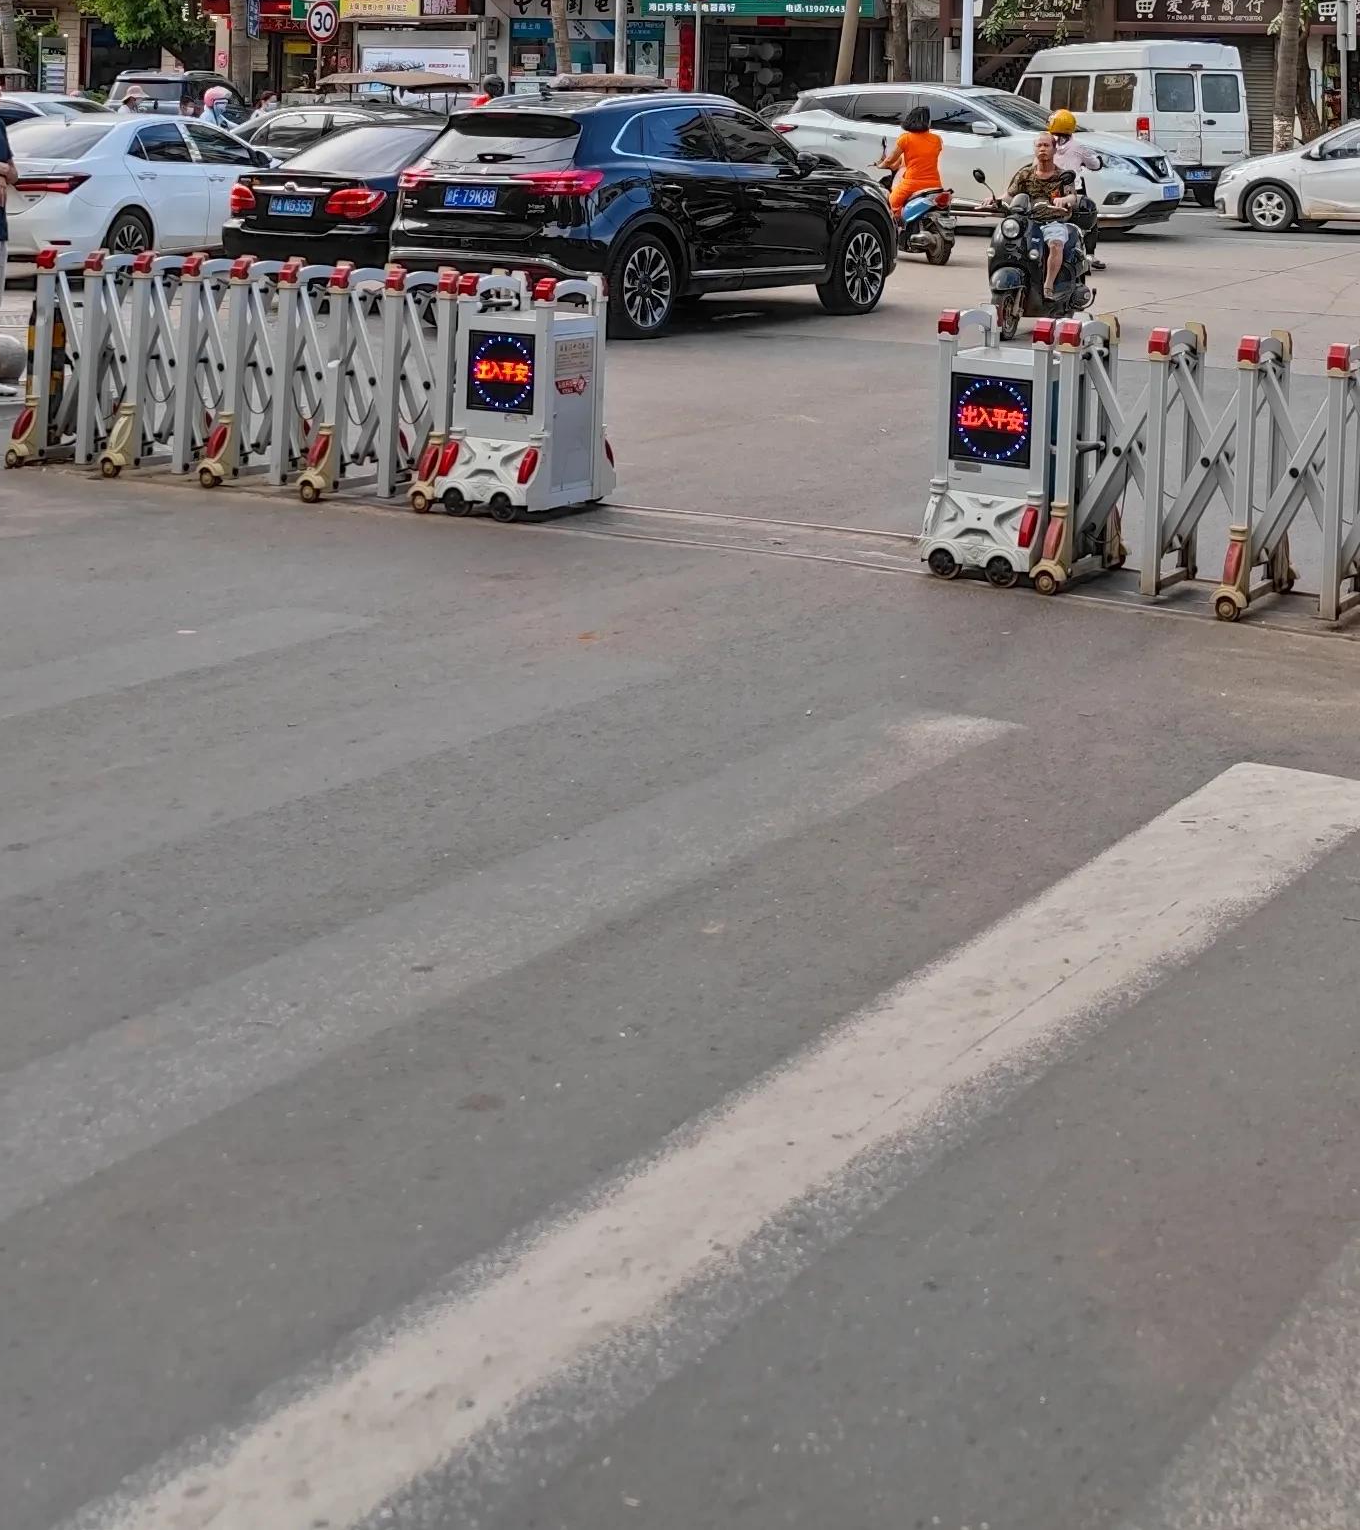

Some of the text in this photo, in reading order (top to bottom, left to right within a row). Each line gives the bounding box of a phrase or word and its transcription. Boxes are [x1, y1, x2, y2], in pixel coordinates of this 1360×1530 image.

[313, 11, 333, 32] 30
[477, 360, 529, 383] 出入平安
[961, 405, 1024, 432] 出入平安
